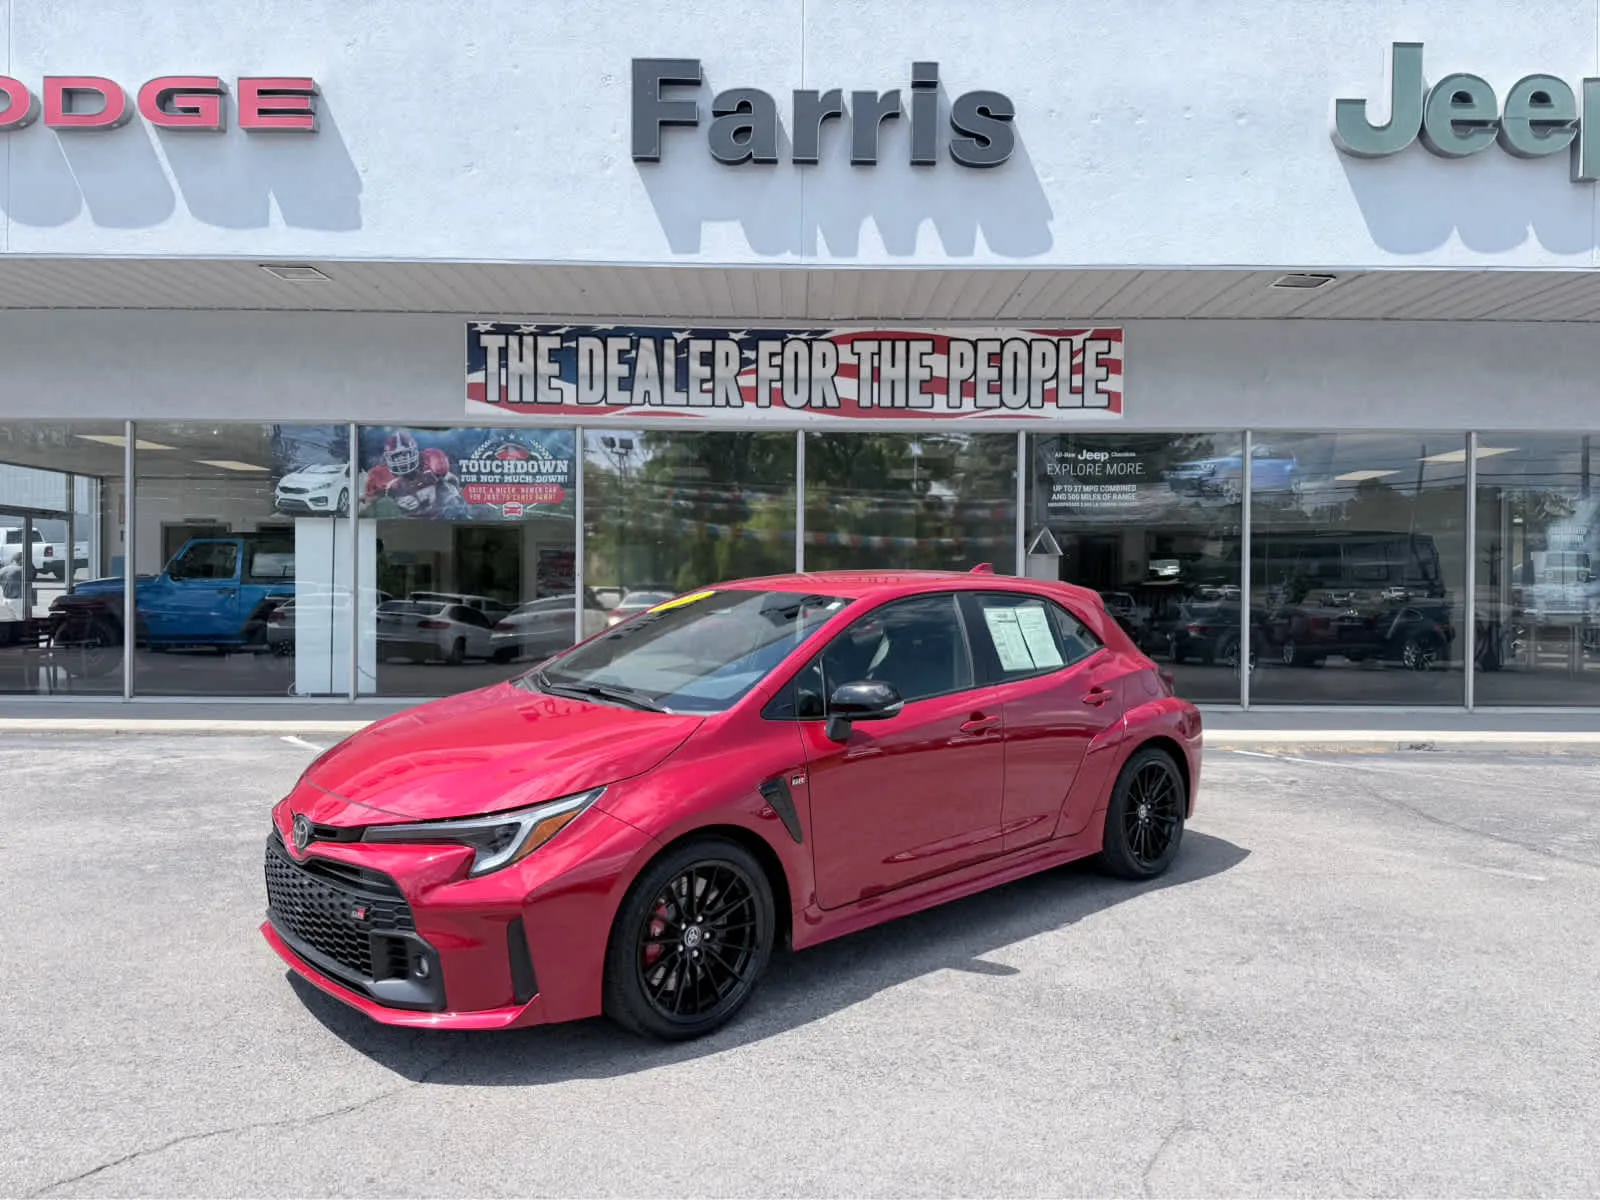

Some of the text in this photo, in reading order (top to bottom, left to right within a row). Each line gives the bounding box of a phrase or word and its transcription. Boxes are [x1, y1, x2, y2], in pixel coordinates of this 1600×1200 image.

[631, 58, 1016, 168] Farris
[1332, 42, 1600, 183] Jee
[479, 333, 1111, 409] THE DEALER FOR THE PEOPLE
[1077, 449, 1110, 462] Jeep
[459, 459, 569, 473] TOUCHDOWN
[1046, 463, 1103, 476] EXPLORE
[461, 475, 568, 483] FOR NOT MUCH DOWN!
[1053, 485, 1062, 493] UP
[1100, 484, 1137, 492] COMBINED
